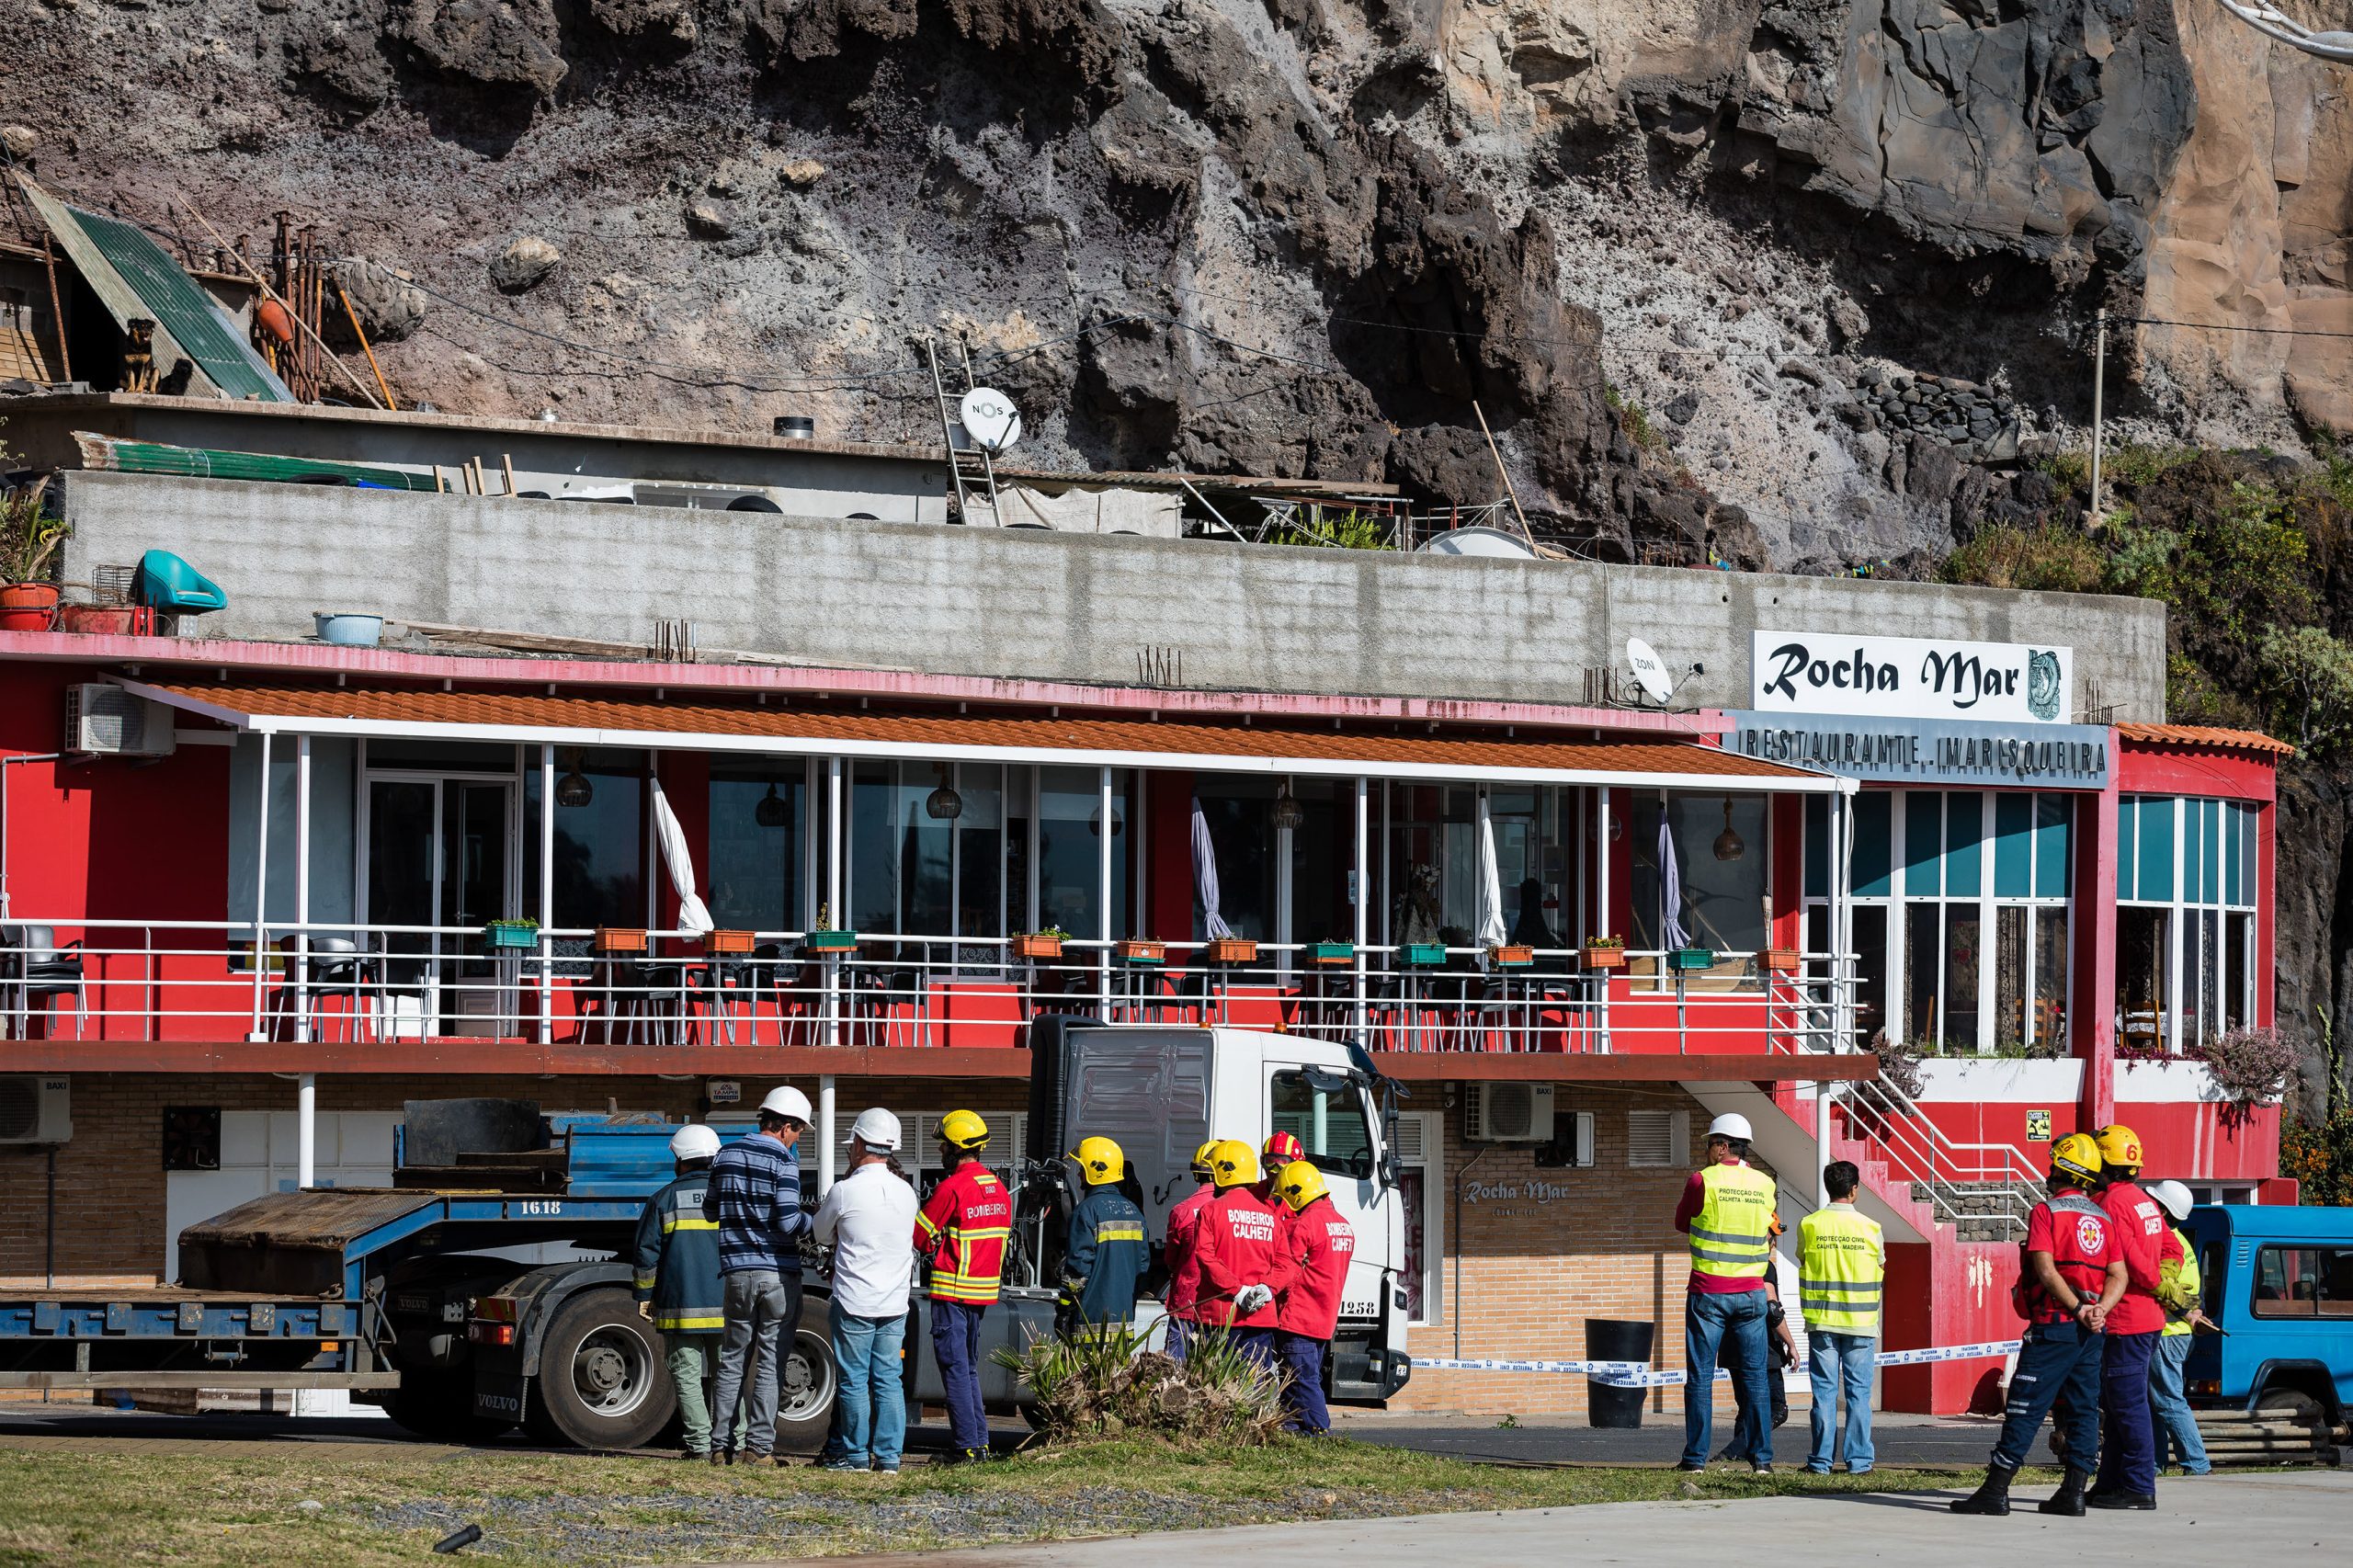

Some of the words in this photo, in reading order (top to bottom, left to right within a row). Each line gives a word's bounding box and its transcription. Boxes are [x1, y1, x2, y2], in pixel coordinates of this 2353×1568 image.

[972, 403, 1003, 418] NOS
[1634, 657, 1655, 671] ZON
[1763, 643, 1899, 702] Rocha
[1921, 648, 2019, 710] Mar
[1941, 736, 2106, 775] MARISQUEIRA
[46, 1082, 67, 1090] BAXI
[2060, 1140, 2075, 1153] 28
[2126, 1144, 2138, 1161] 6
[1463, 1180, 1517, 1205] Rocha
[1523, 1180, 1569, 1204] Mar
[1753, 1190, 1765, 1199] CIVIL
[1745, 1198, 1766, 1206] MADEIRA
[967, 1203, 1007, 1220] BOMBEIROS
[1227, 1209, 1275, 1228] BOMBEIROS
[1233, 1223, 1273, 1243] CALHETA
[1331, 1237, 1354, 1252] CALHET
[399, 1298, 428, 1310] VOLVO
[478, 1393, 518, 1412] VOLVO
